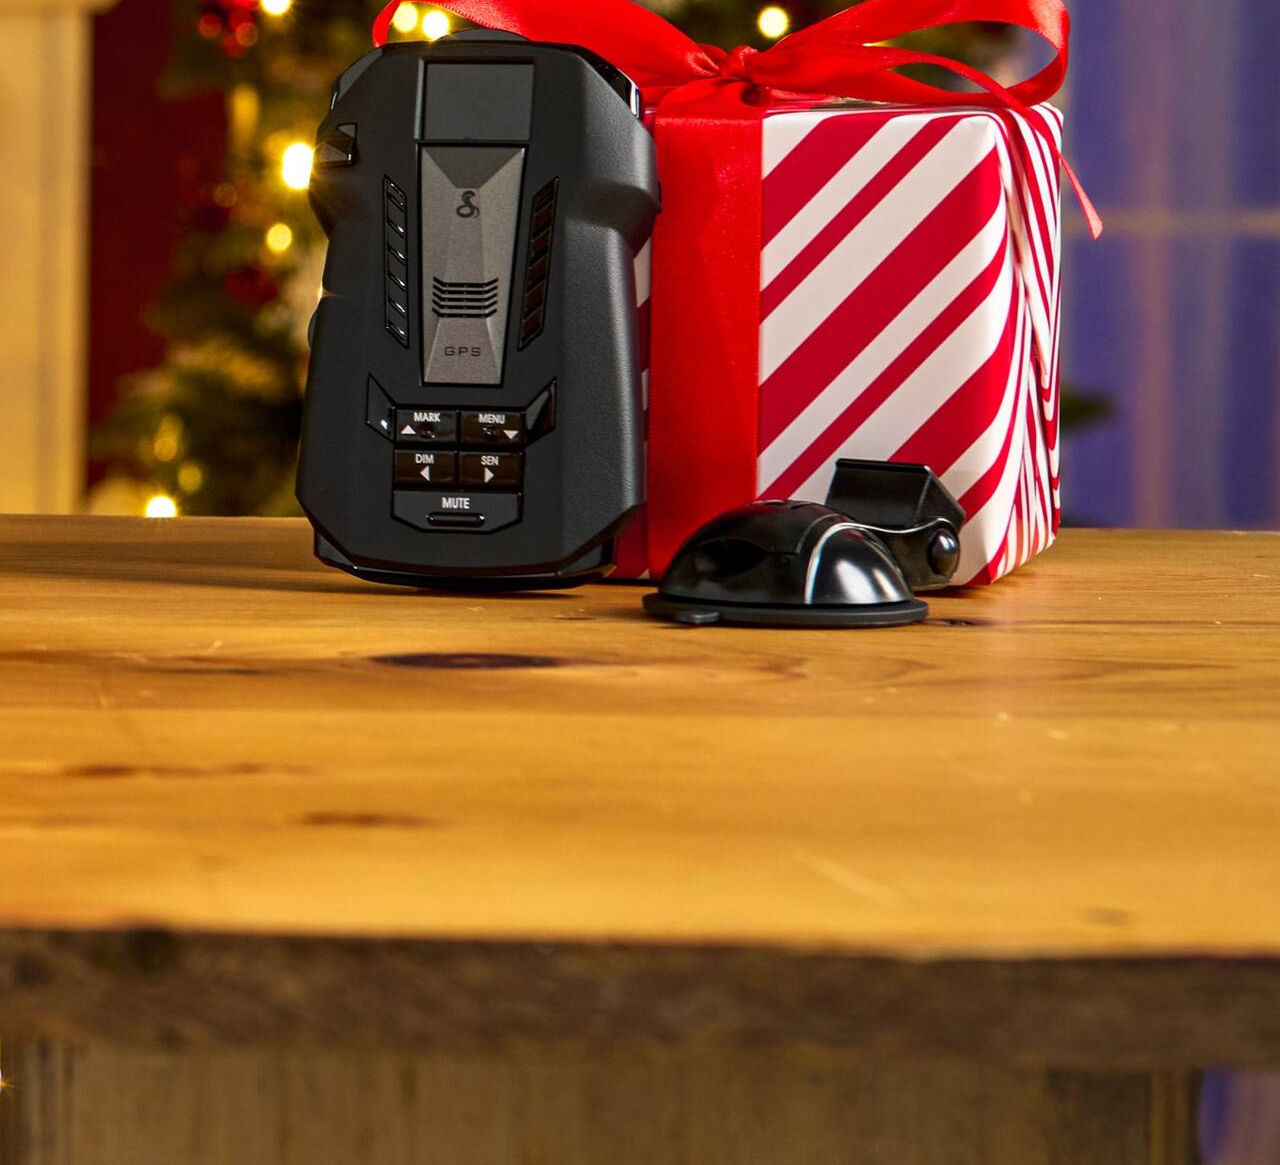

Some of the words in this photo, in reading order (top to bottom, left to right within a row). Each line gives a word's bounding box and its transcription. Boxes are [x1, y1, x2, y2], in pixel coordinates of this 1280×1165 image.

[444, 346, 481, 357] GPS
[413, 412, 441, 422] MARK
[478, 413, 506, 424] MENU
[415, 454, 434, 464] DIM
[481, 455, 499, 466] SEN
[442, 497, 470, 509] MUTE
